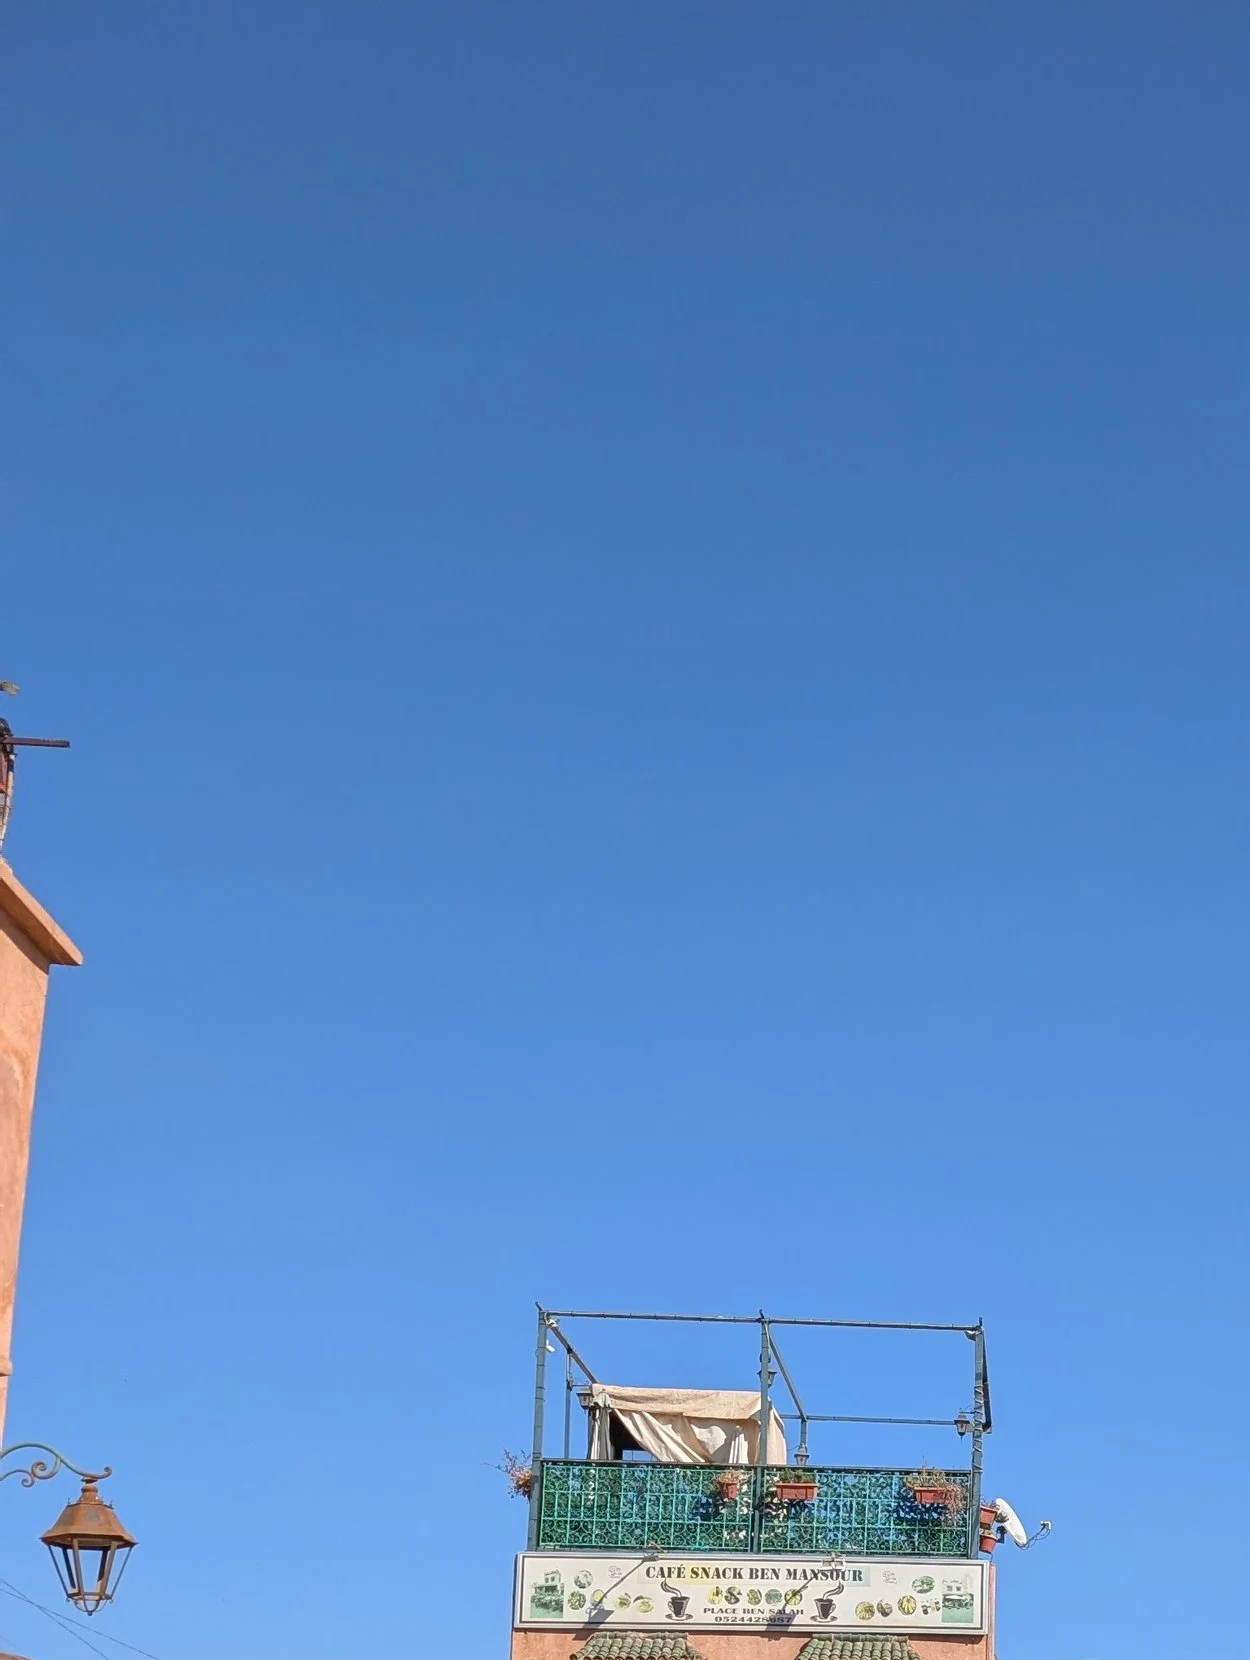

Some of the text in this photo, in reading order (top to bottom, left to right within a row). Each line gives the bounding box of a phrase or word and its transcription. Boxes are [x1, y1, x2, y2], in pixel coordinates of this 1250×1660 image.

[645, 1563, 863, 1581] CAFÉ SNACK BEN MANSOUR
[703, 1607, 739, 1615] PLACE
